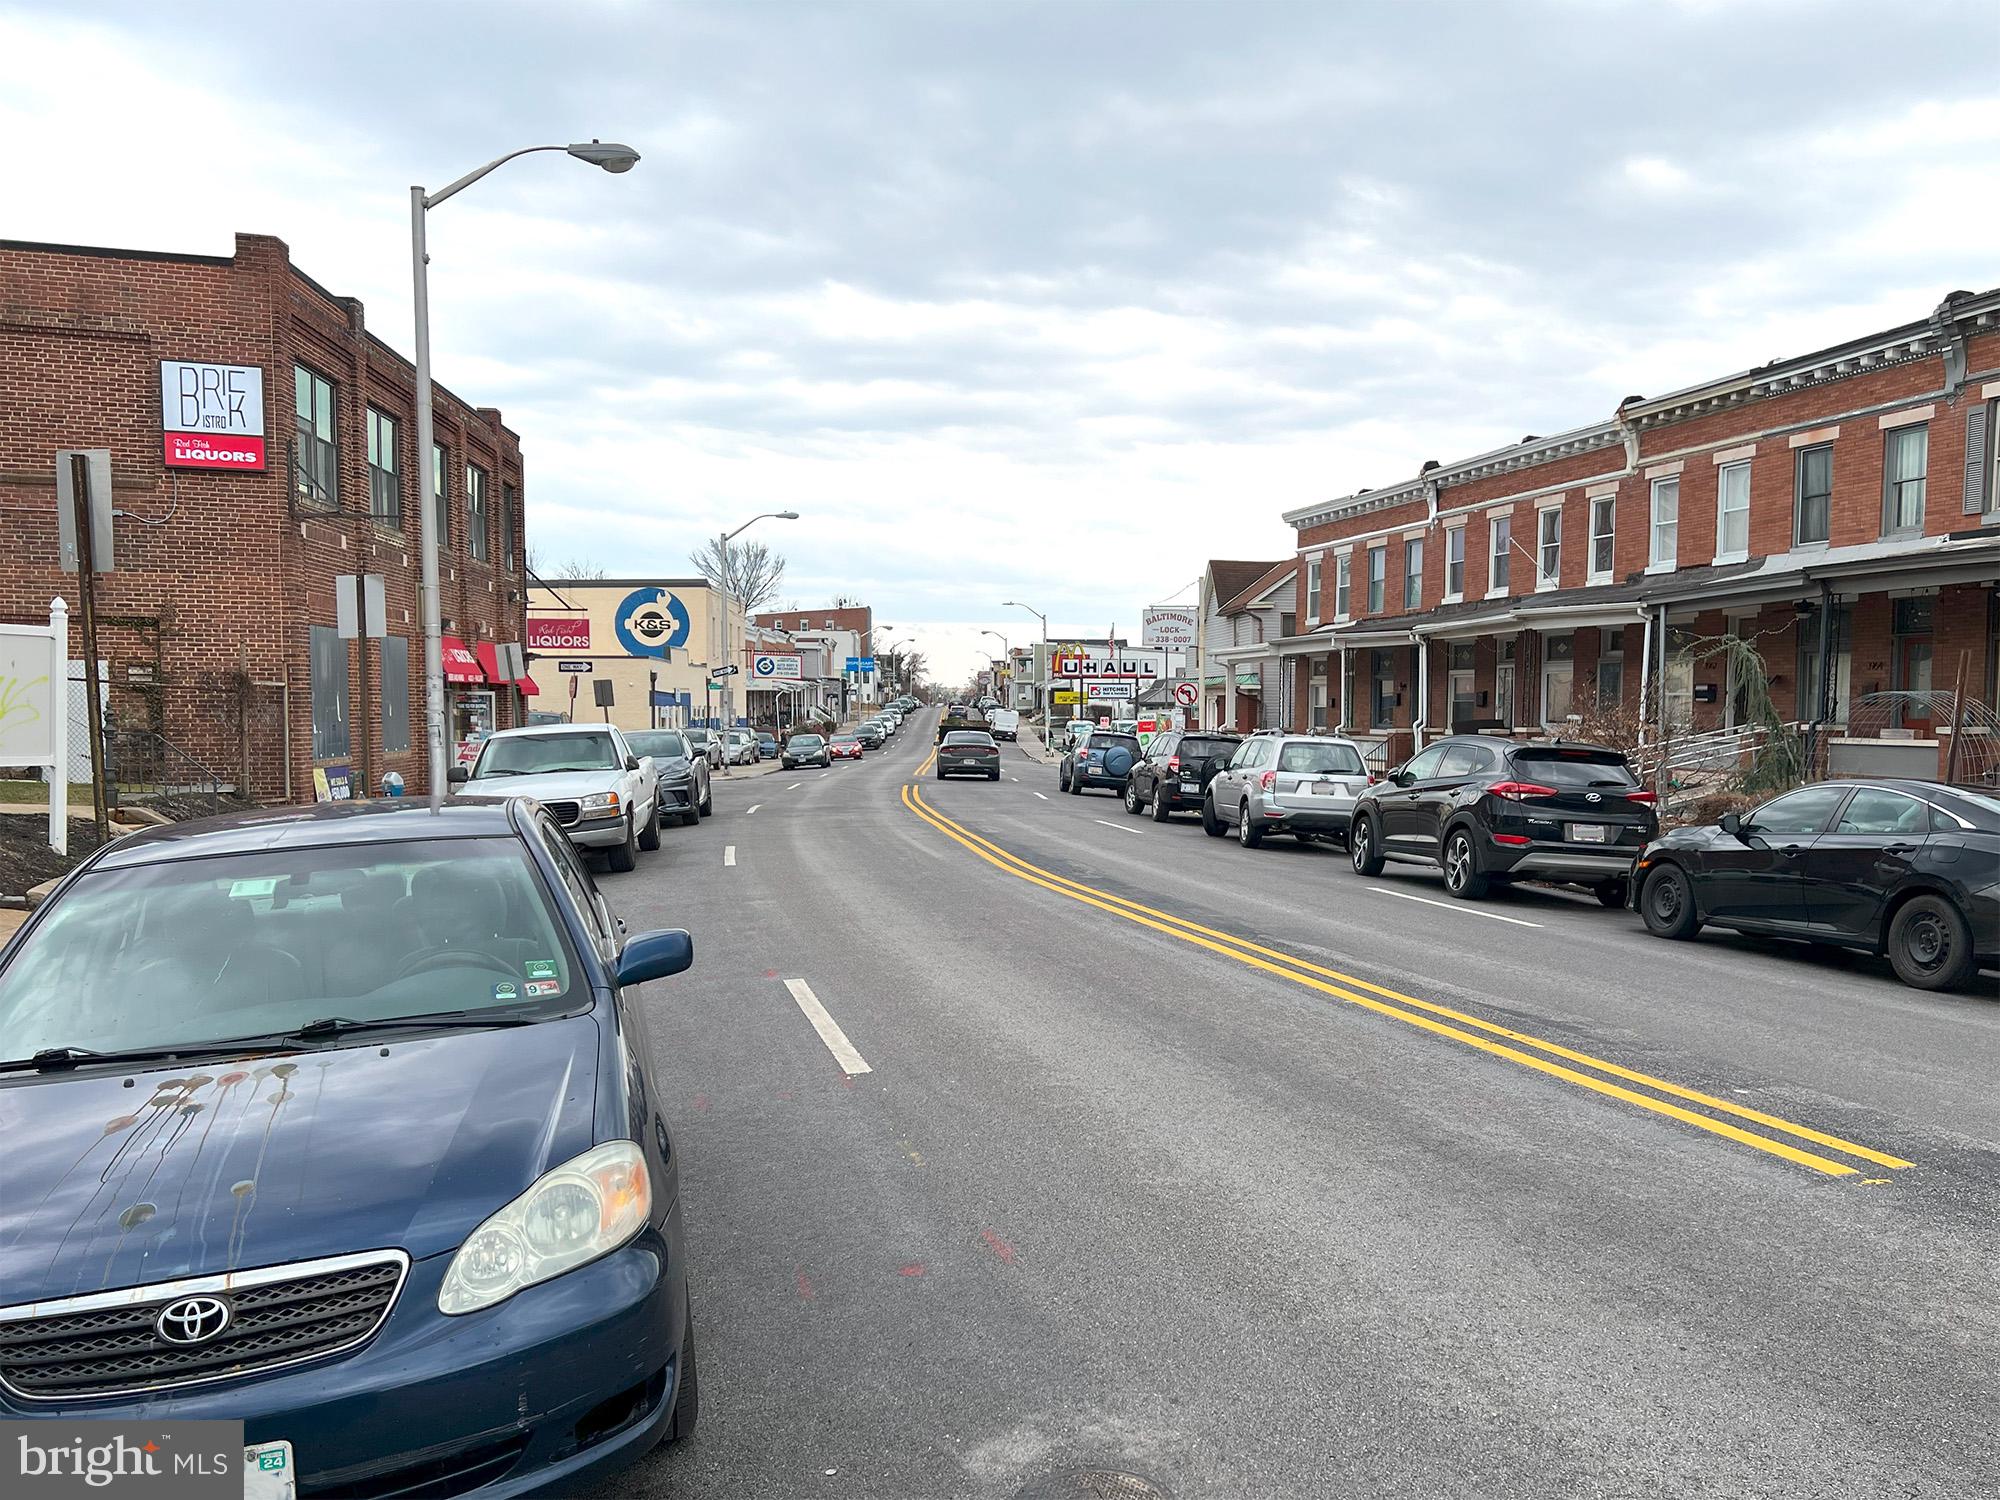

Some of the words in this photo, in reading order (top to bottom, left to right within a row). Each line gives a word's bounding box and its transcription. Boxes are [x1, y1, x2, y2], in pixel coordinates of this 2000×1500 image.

[175, 448, 257, 463] LIQUORS
[634, 619, 672, 630] K&S
[1145, 612, 1195, 627] BALTIMORE
[1159, 626, 1180, 634] LOCK
[529, 634, 590, 648] LIQUORS
[1155, 635, 1192, 644] 338-0007
[529, 984, 538, 993] 9
[263, 1457, 284, 1469] 24
